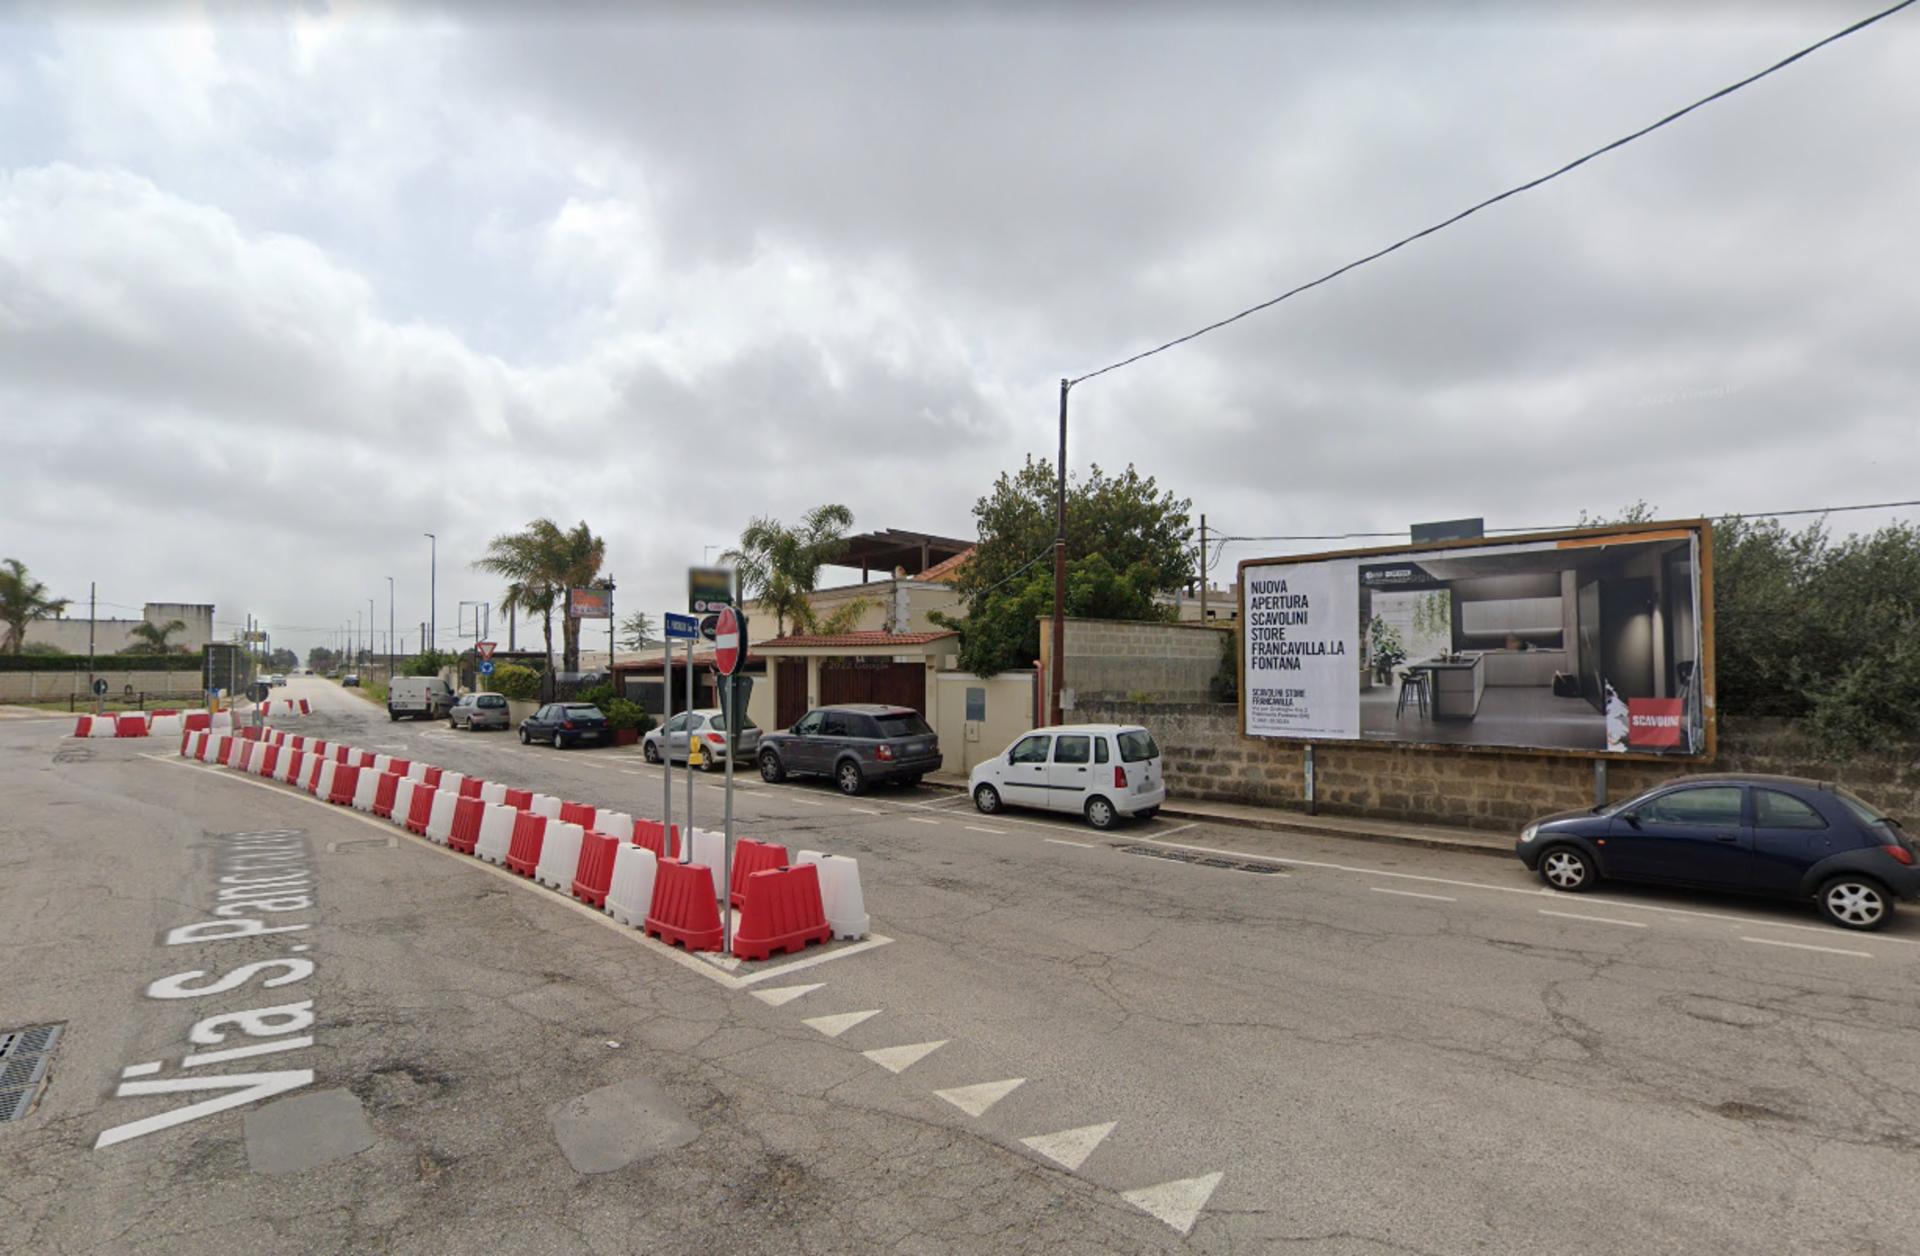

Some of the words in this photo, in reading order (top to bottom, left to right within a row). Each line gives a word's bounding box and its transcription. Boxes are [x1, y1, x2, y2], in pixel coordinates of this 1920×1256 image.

[1251, 580, 1288, 594] NUOVA
[1251, 595, 1309, 610] APERTURA
[1251, 611, 1308, 626] SCAVOLINI
[1251, 628, 1286, 641] STORE
[1251, 657, 1301, 670] FONTANA
[1632, 715, 1680, 727] SCAVOLINI
